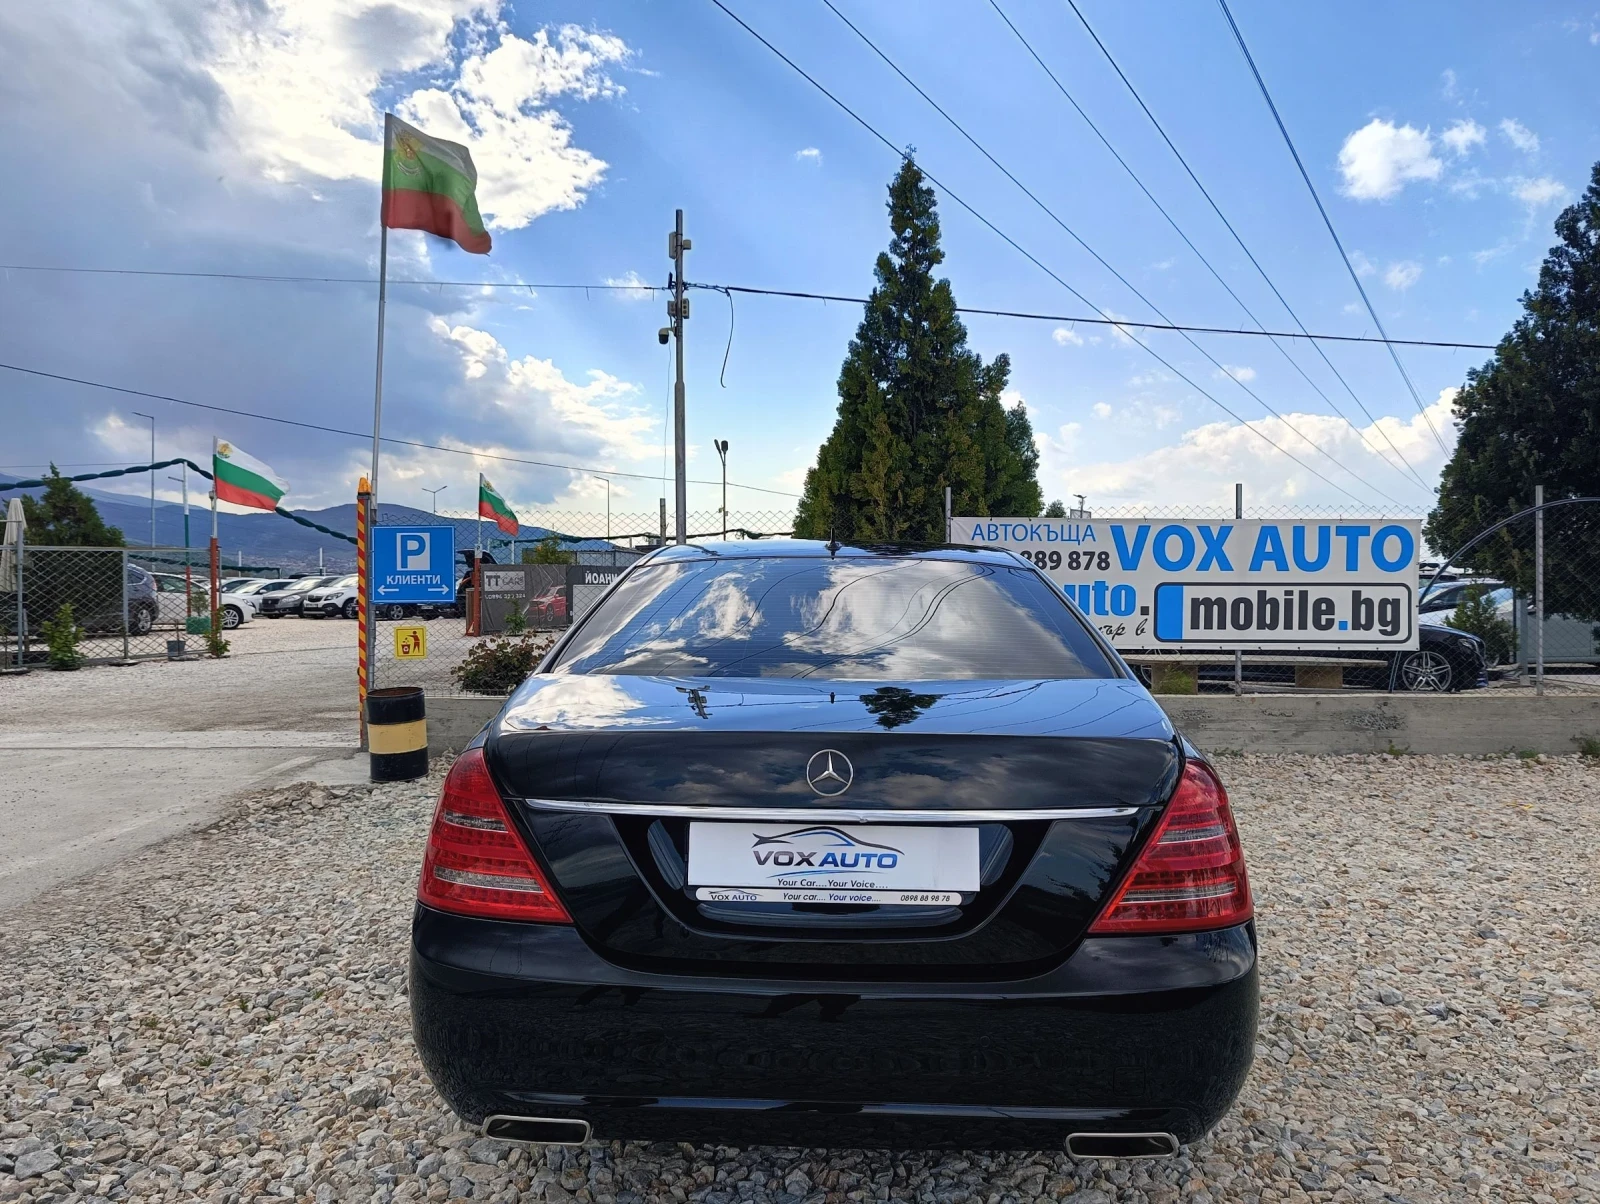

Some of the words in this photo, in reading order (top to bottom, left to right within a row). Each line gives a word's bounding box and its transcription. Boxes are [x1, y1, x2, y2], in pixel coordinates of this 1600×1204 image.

[971, 523, 1096, 545] АВТОКЪЩА
[401, 534, 426, 569] P
[1109, 524, 1235, 572] VOX
[1248, 524, 1415, 573] AUTO
[1067, 550, 1110, 571] 878
[386, 574, 441, 585] КЛИЕНТИ
[486, 575, 500, 587] TT
[1190, 589, 1401, 636] mobile.bg
[777, 878, 798, 887] Your
[783, 892, 801, 901] Your
[829, 893, 847, 902] Your
[900, 894, 918, 902] 0898
[920, 894, 929, 902] 88
[931, 894, 940, 902] 98
[941, 894, 951, 902] 78
